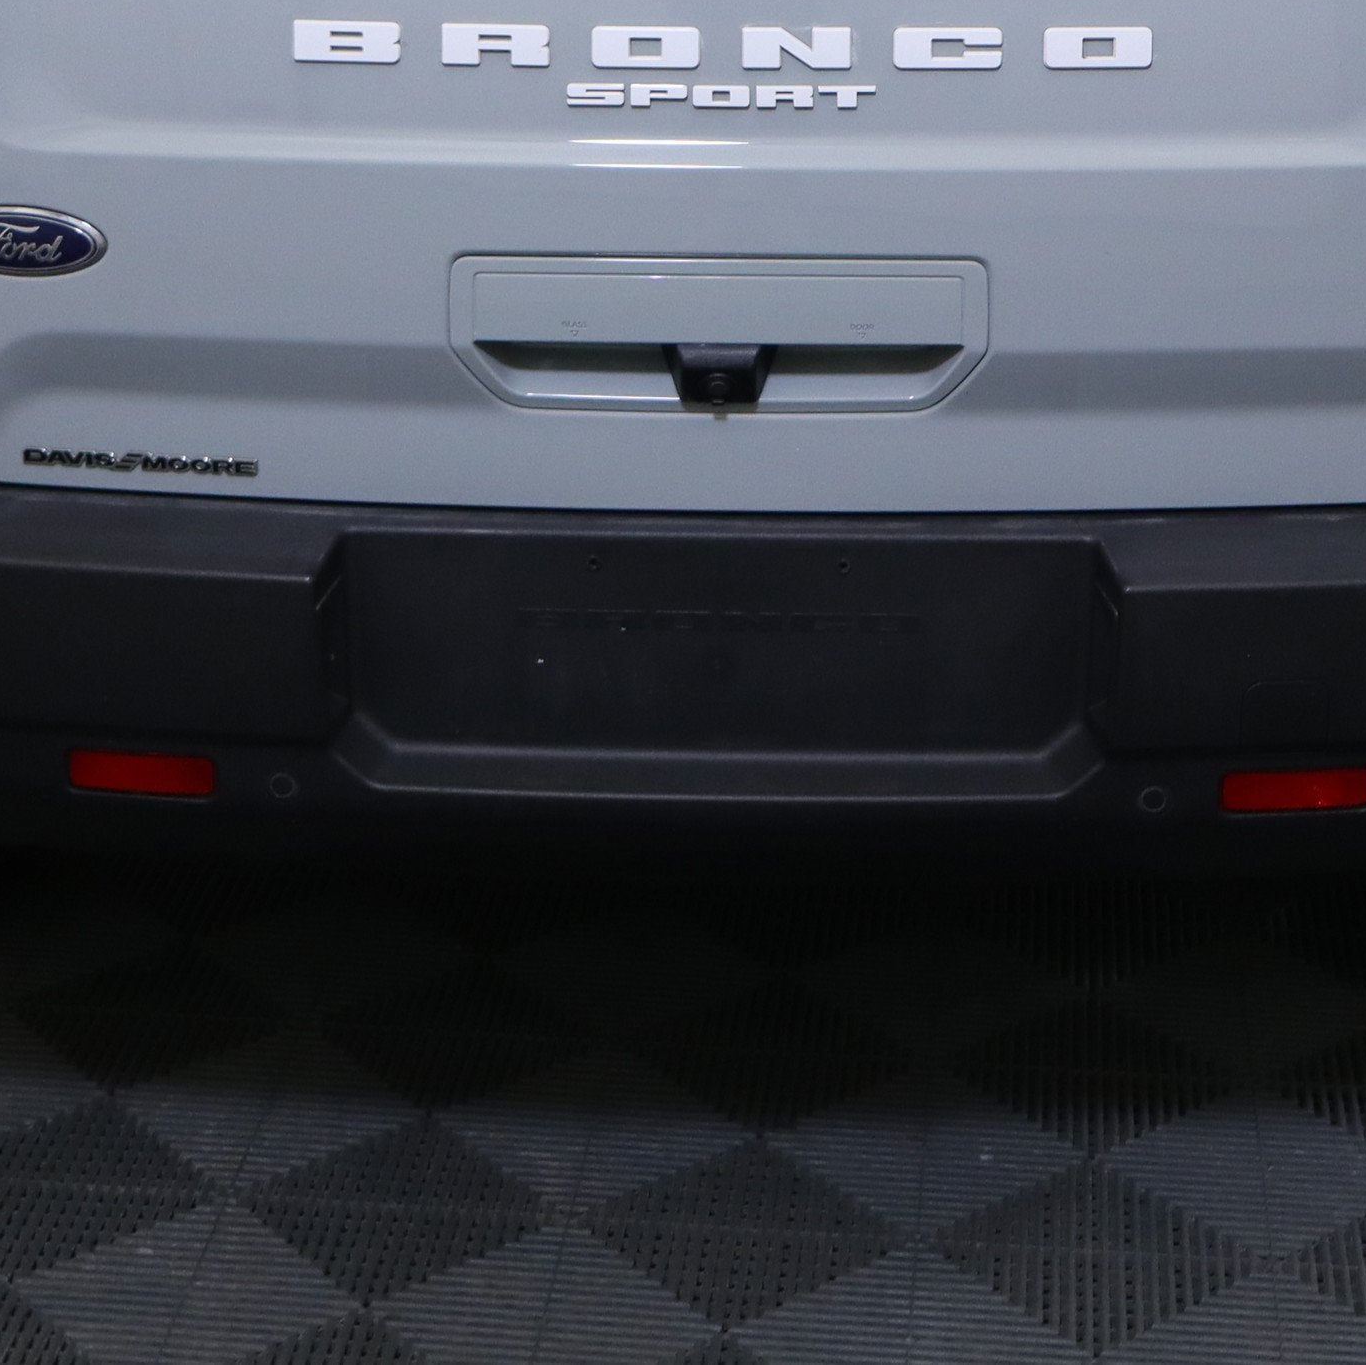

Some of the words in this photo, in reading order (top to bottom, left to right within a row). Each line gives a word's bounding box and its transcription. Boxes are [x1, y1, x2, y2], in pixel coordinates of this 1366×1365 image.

[292, 18, 1153, 69] BRONCO
[566, 82, 877, 109] SPORT
[23, 447, 116, 468] DAVIS
[141, 453, 259, 476] MOORE
